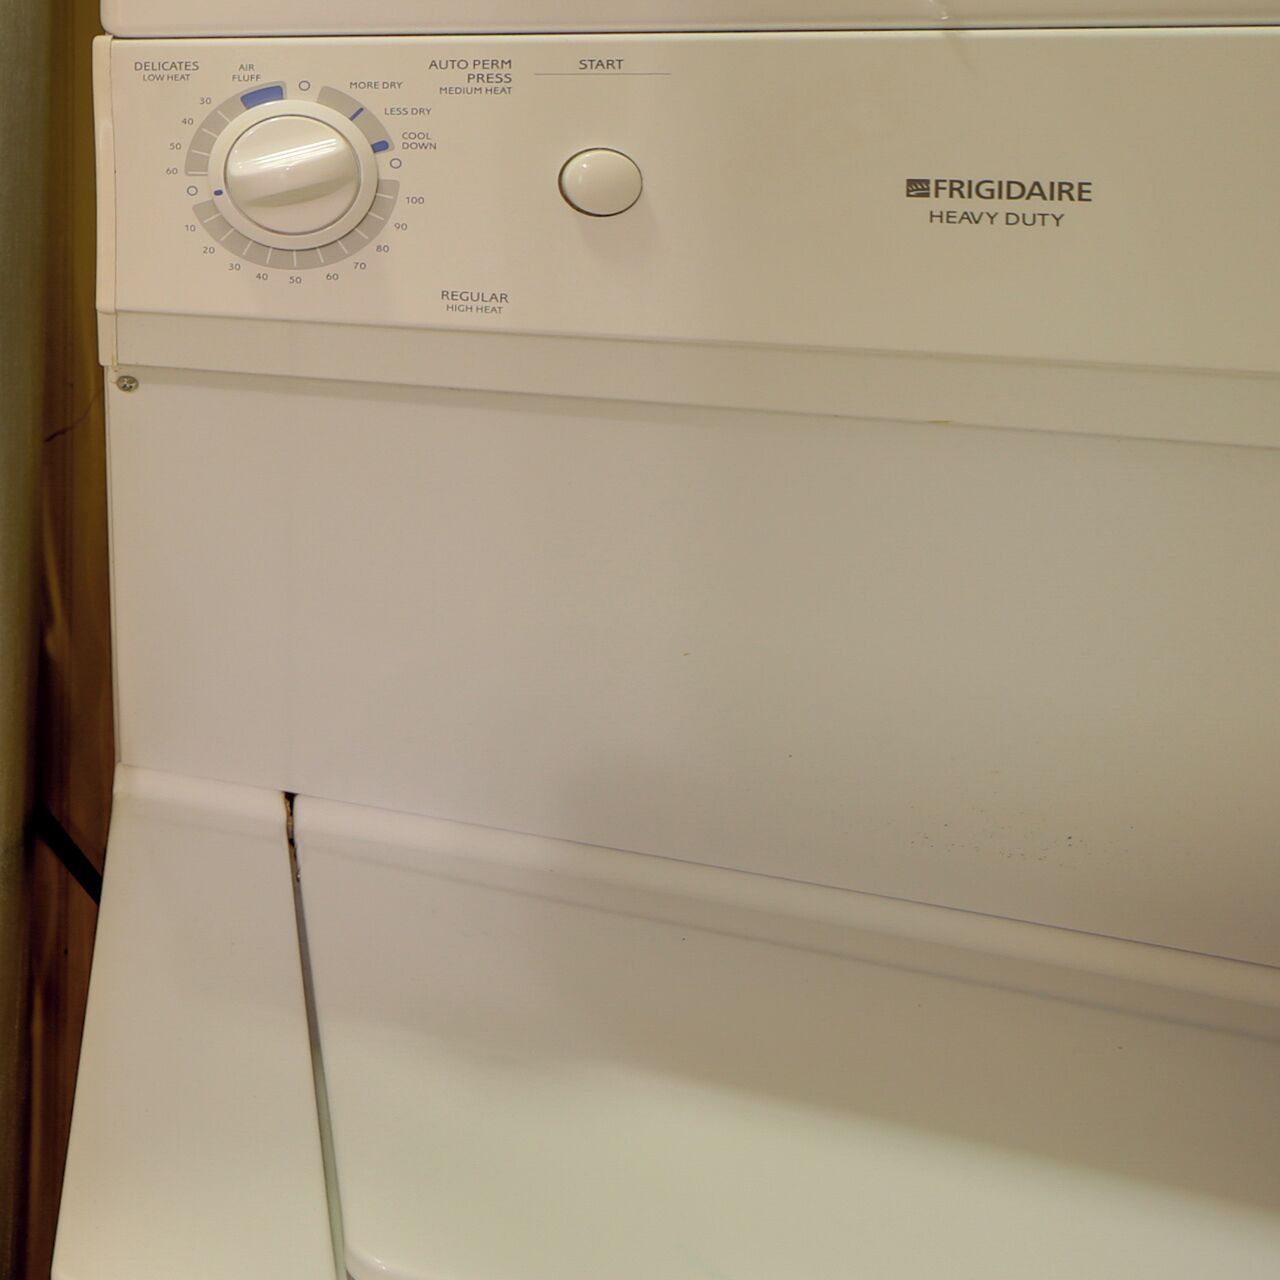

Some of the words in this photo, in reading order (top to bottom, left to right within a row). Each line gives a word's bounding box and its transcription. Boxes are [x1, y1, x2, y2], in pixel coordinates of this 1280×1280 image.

[134, 61, 200, 71] DELICATES
[238, 63, 255, 71] AIR
[428, 59, 469, 70] AUTO
[472, 59, 512, 70] PERM
[578, 59, 624, 70] START
[143, 73, 164, 81] LOW
[166, 73, 190, 81] HEAT
[232, 74, 261, 82] FLUFF
[467, 73, 512, 84] PRESS
[349, 81, 379, 89] MORE
[382, 81, 403, 89] DRY
[439, 86, 482, 95] MEDIUM
[485, 86, 512, 95] HEAT
[199, 96, 212, 105] 30
[384, 107, 409, 116] LESS
[411, 107, 432, 116] DRY
[181, 117, 194, 125] 40
[401, 131, 431, 140] COOL
[169, 142, 182, 151] 50
[401, 142, 437, 150] DOWN
[166, 167, 178, 175] 60
[934, 179, 1092, 202] FRIGIDAIRE
[405, 196, 425, 205] 100
[929, 210, 999, 225] HEAVY
[1005, 212, 1065, 227] DUTY
[185, 224, 196, 233] 10
[394, 223, 408, 231] 90
[203, 246, 215, 254] 20
[376, 245, 390, 253] 80
[228, 263, 241, 271] 30
[353, 262, 366, 270] 70
[256, 273, 268, 281] 40
[289, 276, 302, 284] 50
[326, 273, 339, 281] 60
[441, 290, 509, 303] REGULAR
[446, 304, 473, 312] HIGH
[476, 305, 504, 314] HEAT
